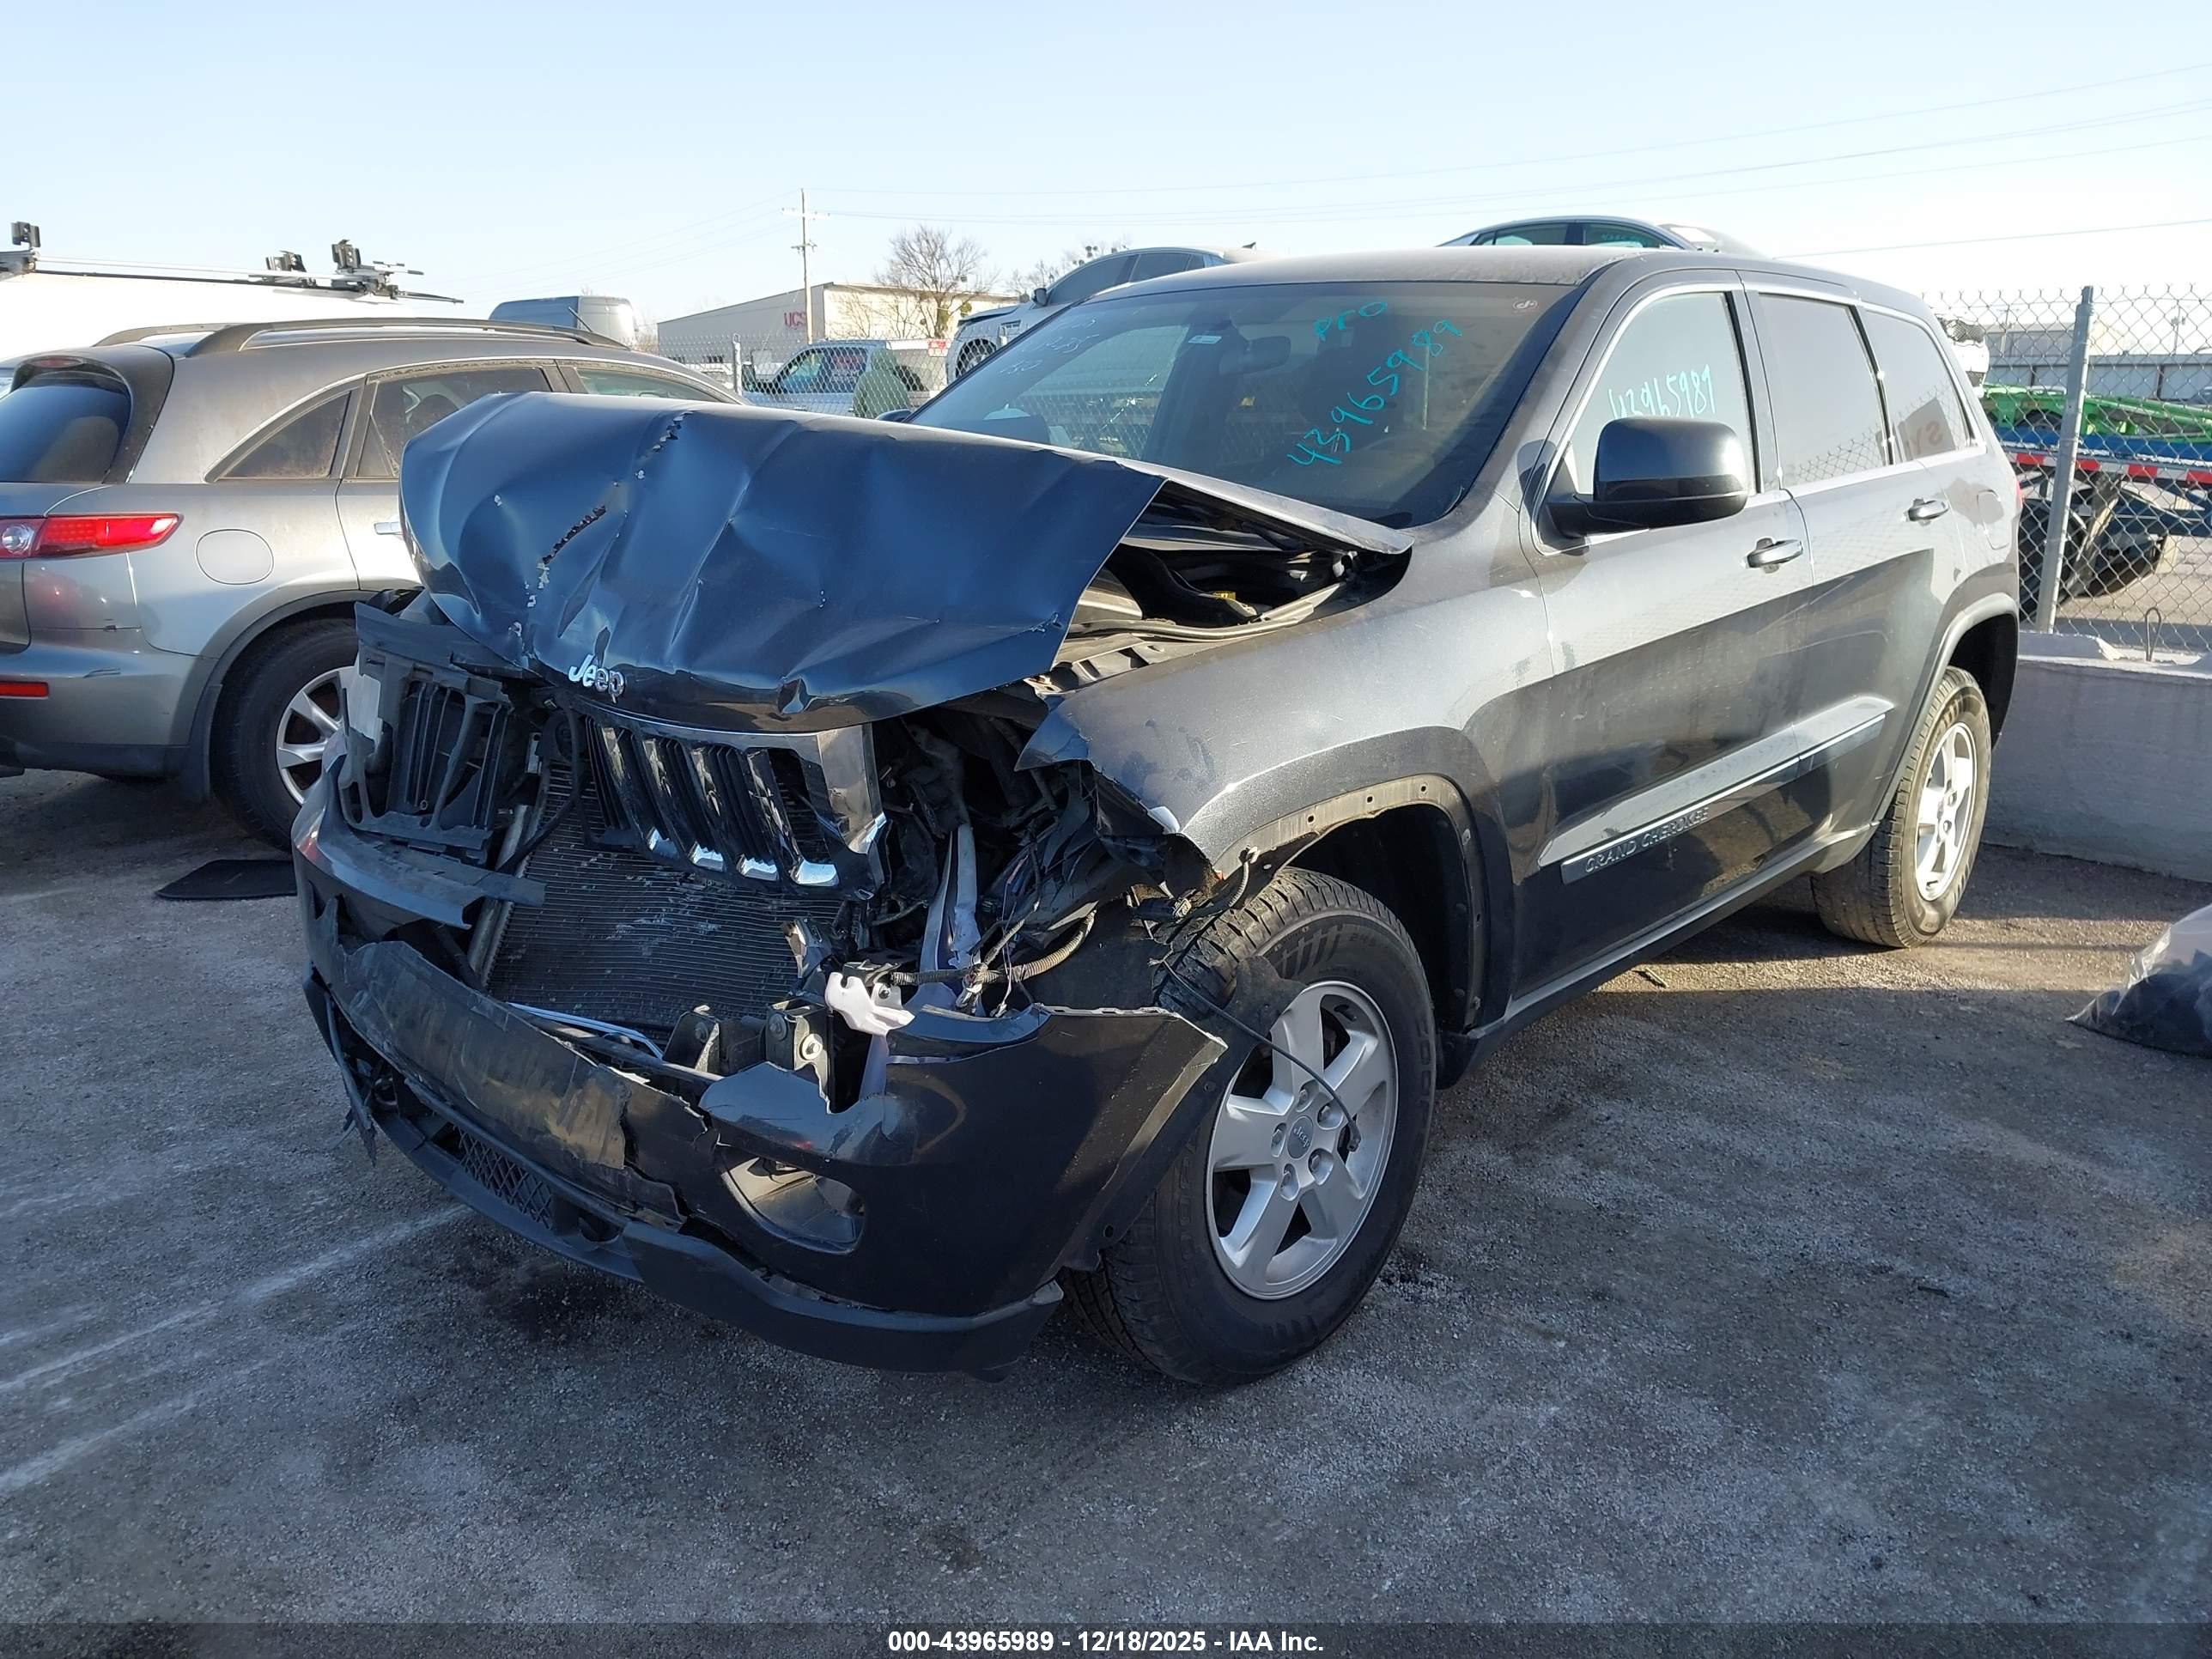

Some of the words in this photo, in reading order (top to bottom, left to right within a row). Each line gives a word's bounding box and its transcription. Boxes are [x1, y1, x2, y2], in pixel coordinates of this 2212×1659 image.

[1286, 319, 1463, 465] 43965989
[568, 653, 626, 704] Jeep
[1585, 841, 1638, 873] GRAND
[1641, 806, 1711, 848] CHEROKEE
[1292, 1126, 1310, 1148] Jeep
